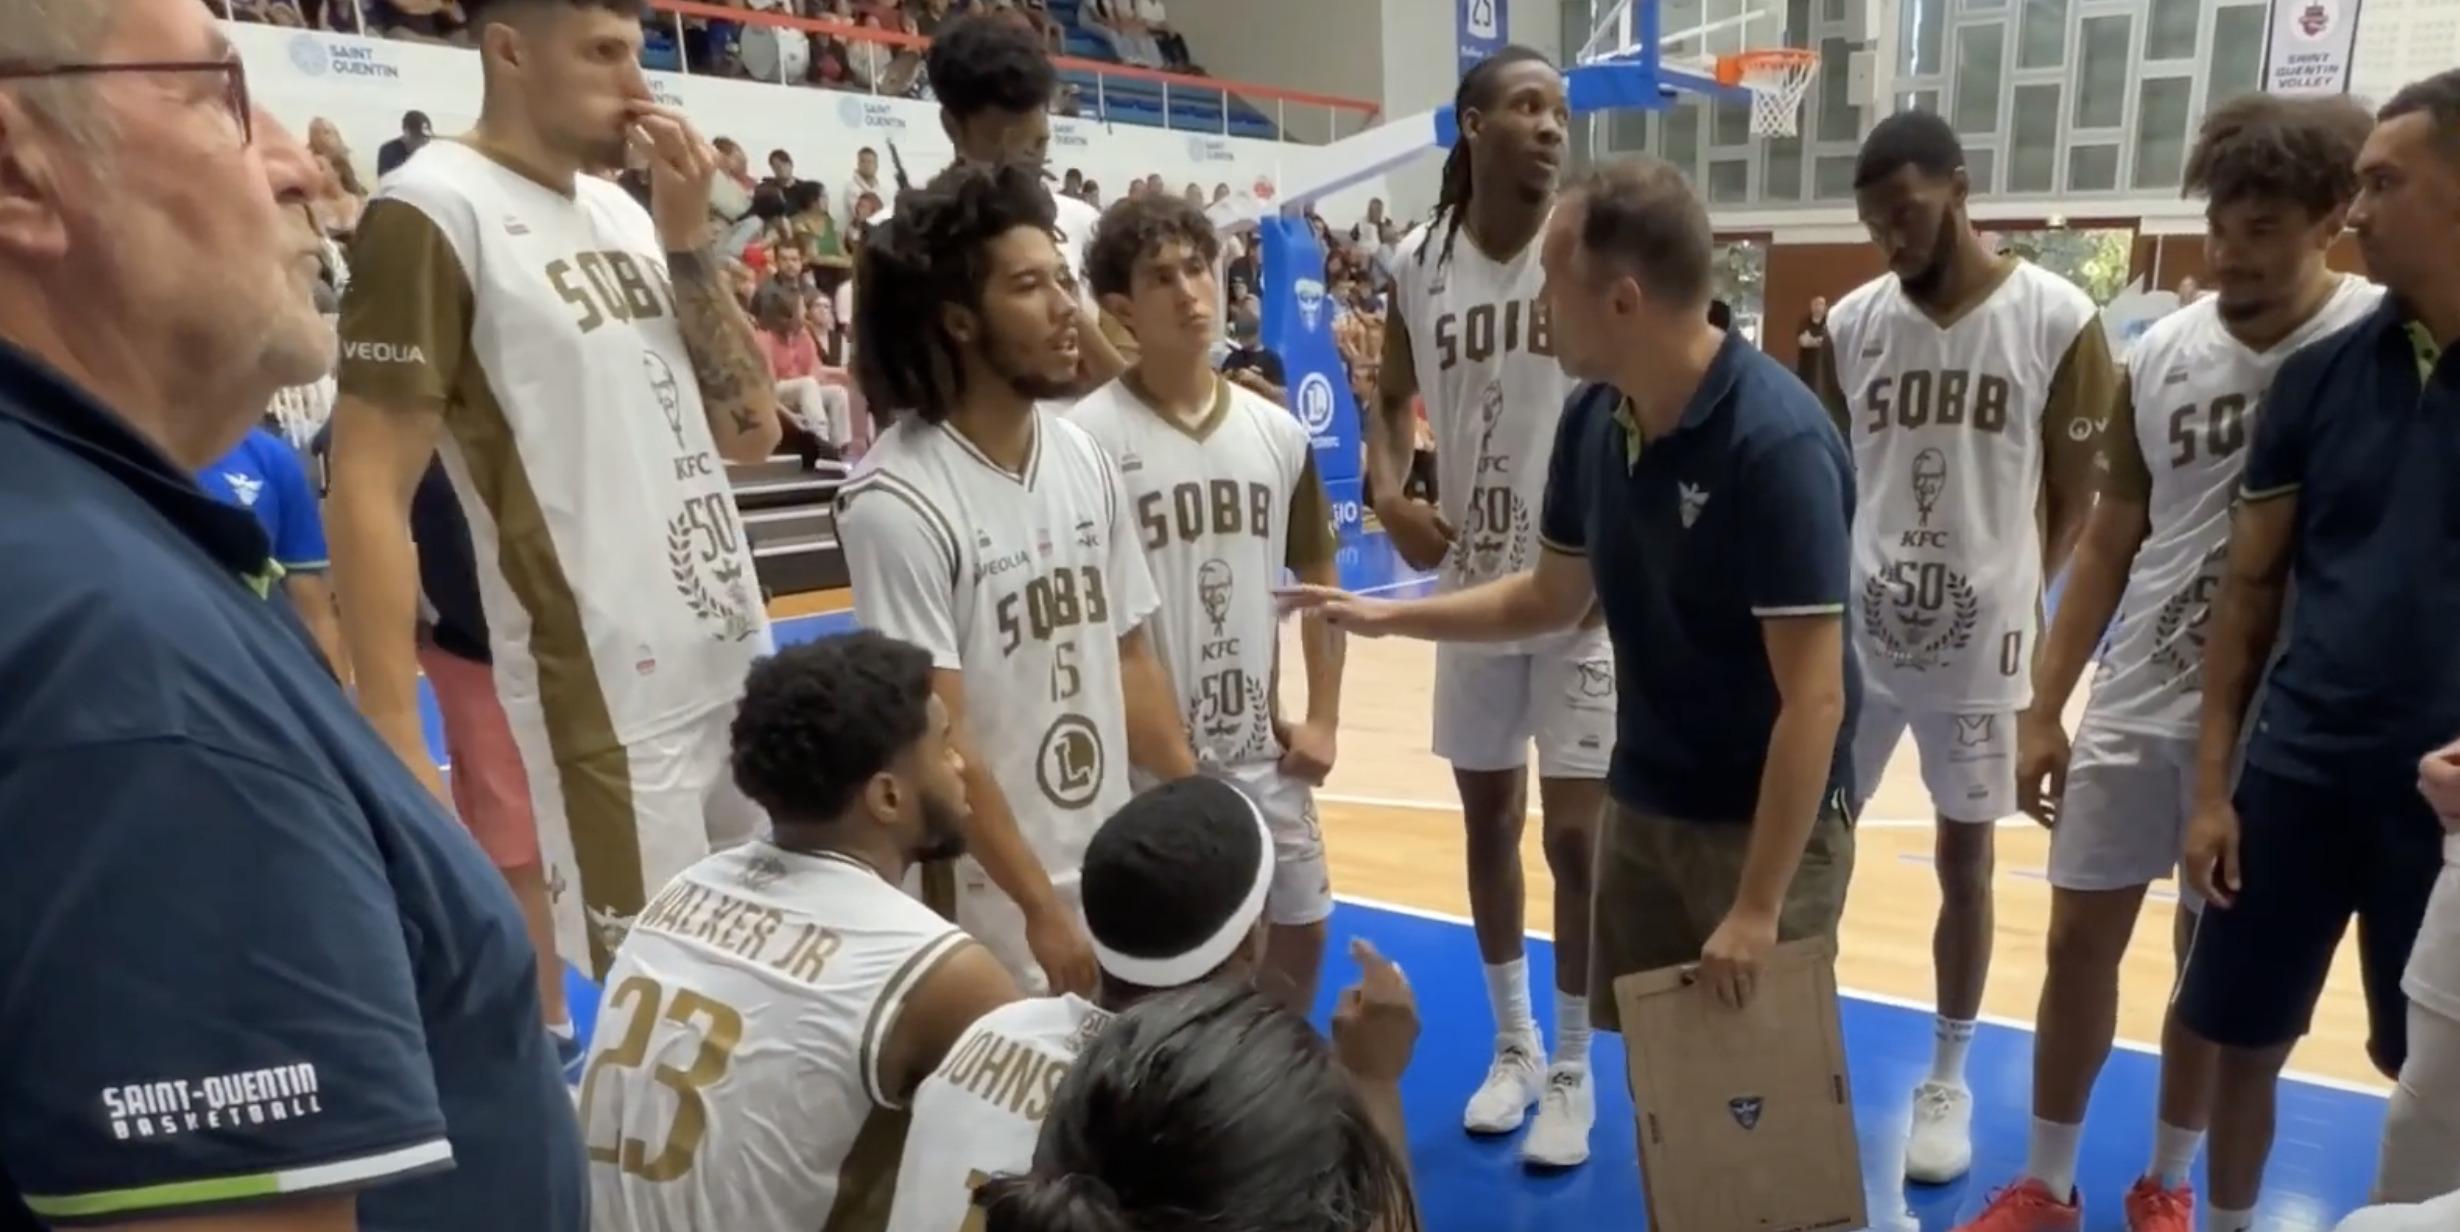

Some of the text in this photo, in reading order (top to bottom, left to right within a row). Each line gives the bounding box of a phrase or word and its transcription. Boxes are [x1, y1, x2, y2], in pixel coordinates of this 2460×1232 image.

[329, 44, 373, 60] SAINT
[332, 59, 399, 78] QUENTIN
[2276, 65, 2339, 77] QUENTIN
[2287, 53, 2330, 64] SAINT
[2278, 77, 2332, 89] VOLLEY
[342, 341, 426, 365] VEOLIA
[1867, 369, 2008, 434] SQBB
[2168, 393, 2246, 469] SQ
[674, 452, 712, 481] KFC
[684, 493, 738, 563] 50
[1137, 479, 1271, 551] SQBB
[1472, 486, 1511, 534] 50
[1900, 529, 1948, 548] KFC
[1893, 560, 1946, 610] 50
[997, 565, 1108, 658] SQBB
[1052, 641, 1081, 702] 15
[1202, 638, 1240, 661] KFC
[2001, 629, 2023, 676] 0
[1202, 668, 1245, 722] 50
[640, 880, 842, 983] WALKER JR
[102, 1062, 318, 1118] SAINT-QUENTIN
[578, 975, 743, 1182] 23
[938, 1028, 1073, 1121] JOHNS
[112, 1095, 322, 1139] BASKETBALL
